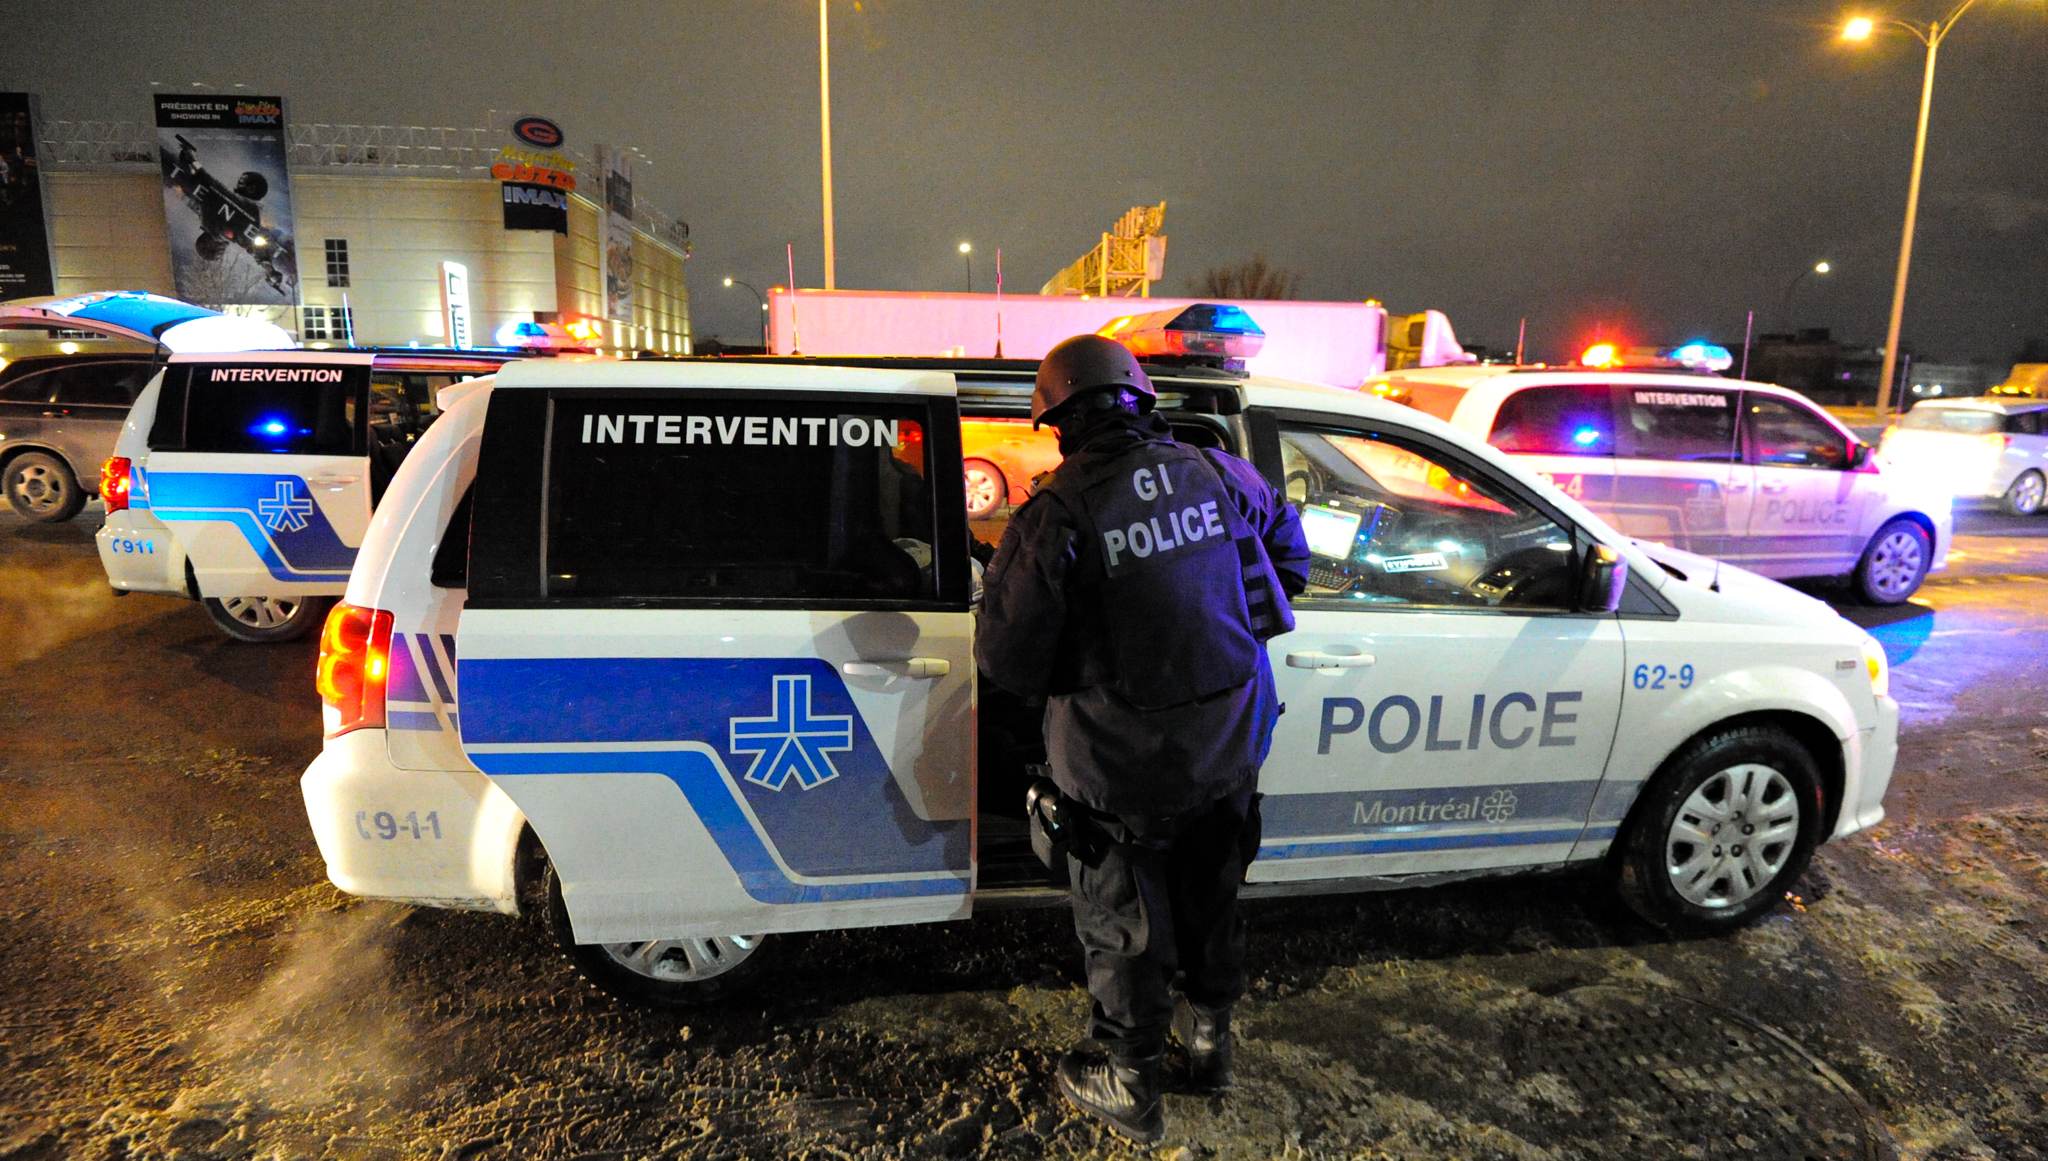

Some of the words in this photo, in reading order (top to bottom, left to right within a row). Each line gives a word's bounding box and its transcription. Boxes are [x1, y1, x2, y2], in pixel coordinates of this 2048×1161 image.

[161, 102, 213, 111] PRÉSENTÉ
[215, 103, 229, 111] EN
[239, 115, 276, 124] IMAX
[503, 185, 567, 210] IMAX
[210, 368, 343, 383] INTERVENTION
[1634, 390, 1728, 408] INTERVENTION
[581, 413, 900, 448] INTERVENTION
[1133, 463, 1175, 501] GI
[1765, 498, 1846, 524] POLICE
[122, 539, 154, 554] 911
[1104, 500, 1225, 567] POLICE
[1633, 663, 1695, 690] 62-9
[1316, 691, 1583, 755] POLICE
[1353, 796, 1480, 825] Montréal
[373, 811, 442, 840] 9-1-1
